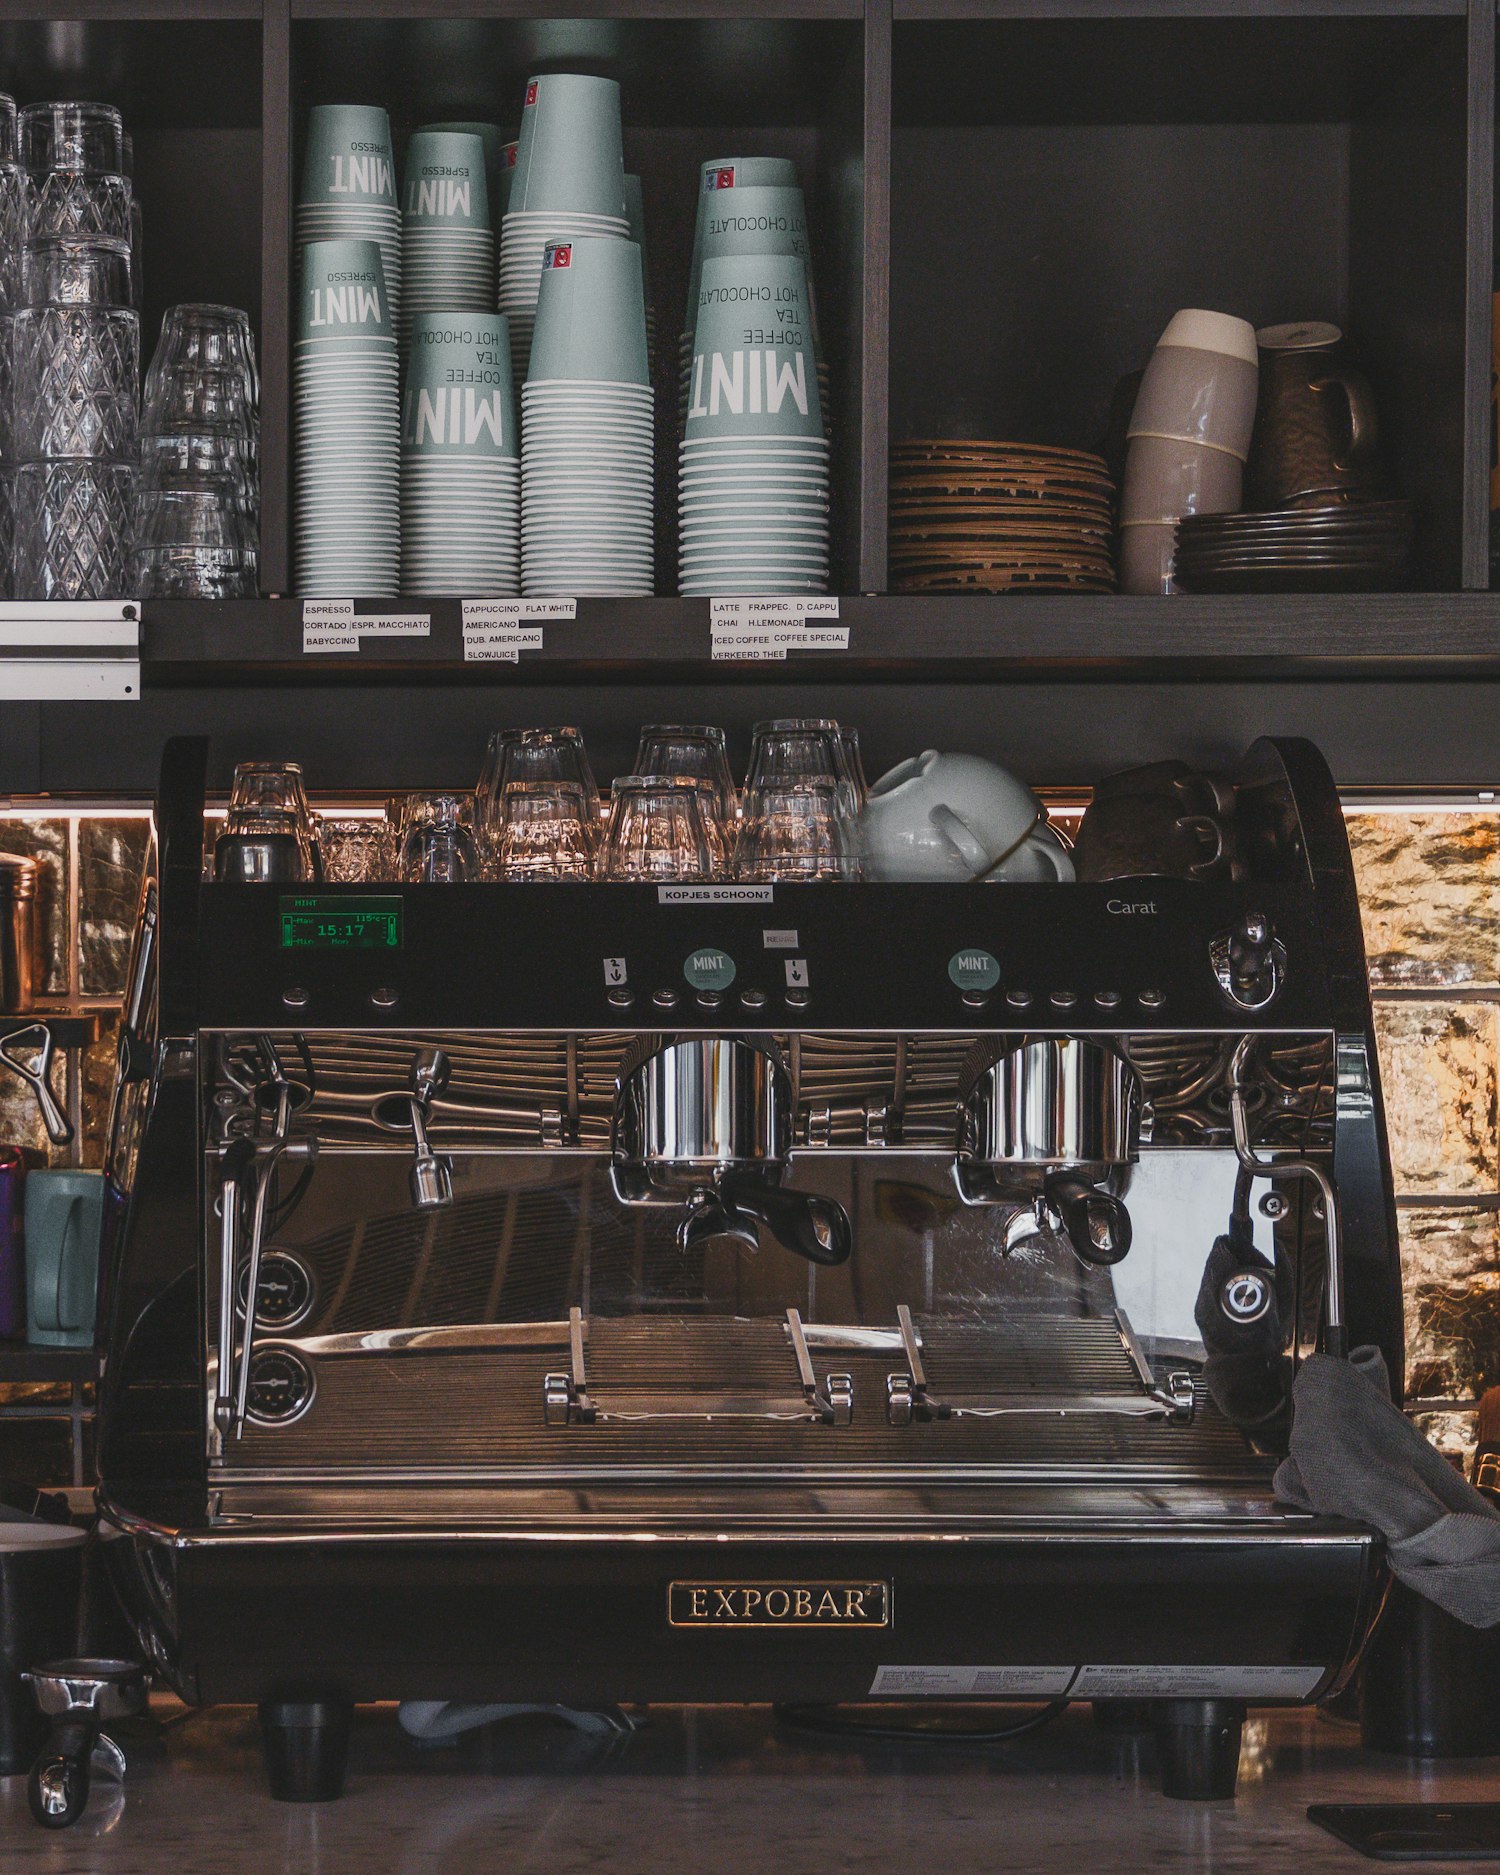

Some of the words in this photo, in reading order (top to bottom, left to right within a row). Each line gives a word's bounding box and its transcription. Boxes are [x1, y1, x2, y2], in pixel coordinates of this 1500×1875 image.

[421, 166, 470, 177] ESPRESSO
[709, 216, 787, 234] CHOCOLATE
[327, 271, 376, 282] ESPRESSO
[774, 287, 799, 302] HOT
[776, 309, 800, 324] TEA
[475, 332, 499, 345] HOT
[743, 329, 802, 345] COFFEE
[476, 351, 500, 365] TEA
[446, 369, 501, 384] COFFEE
[305, 606, 351, 614] ESPRESSO
[463, 604, 520, 613] CAPPUCCINO
[525, 604, 547, 613] FLAT
[548, 604, 575, 612] WHITE
[807, 603, 837, 611] CAPPU
[304, 621, 347, 630] CORTADO
[351, 621, 377, 630] ESPR.
[378, 620, 430, 629] MACCHIATO
[465, 620, 517, 628] AMERICANO
[717, 619, 738, 627] CHAI
[306, 637, 356, 645] BABYCCINO
[466, 636, 486, 644] DUB.
[488, 634, 541, 643] AMERICANO
[736, 636, 770, 644] COFFEE
[774, 634, 807, 642] COFFEE
[810, 634, 846, 642] SPECIAL
[467, 651, 516, 659] SLOWJUICE
[763, 650, 785, 658] THEE
[665, 891, 711, 899] KOPJES
[713, 890, 770, 899] SCHOON?
[294, 899, 317, 907] MINT
[1106, 899, 1157, 914] Carat
[318, 925, 364, 936] 15:17
